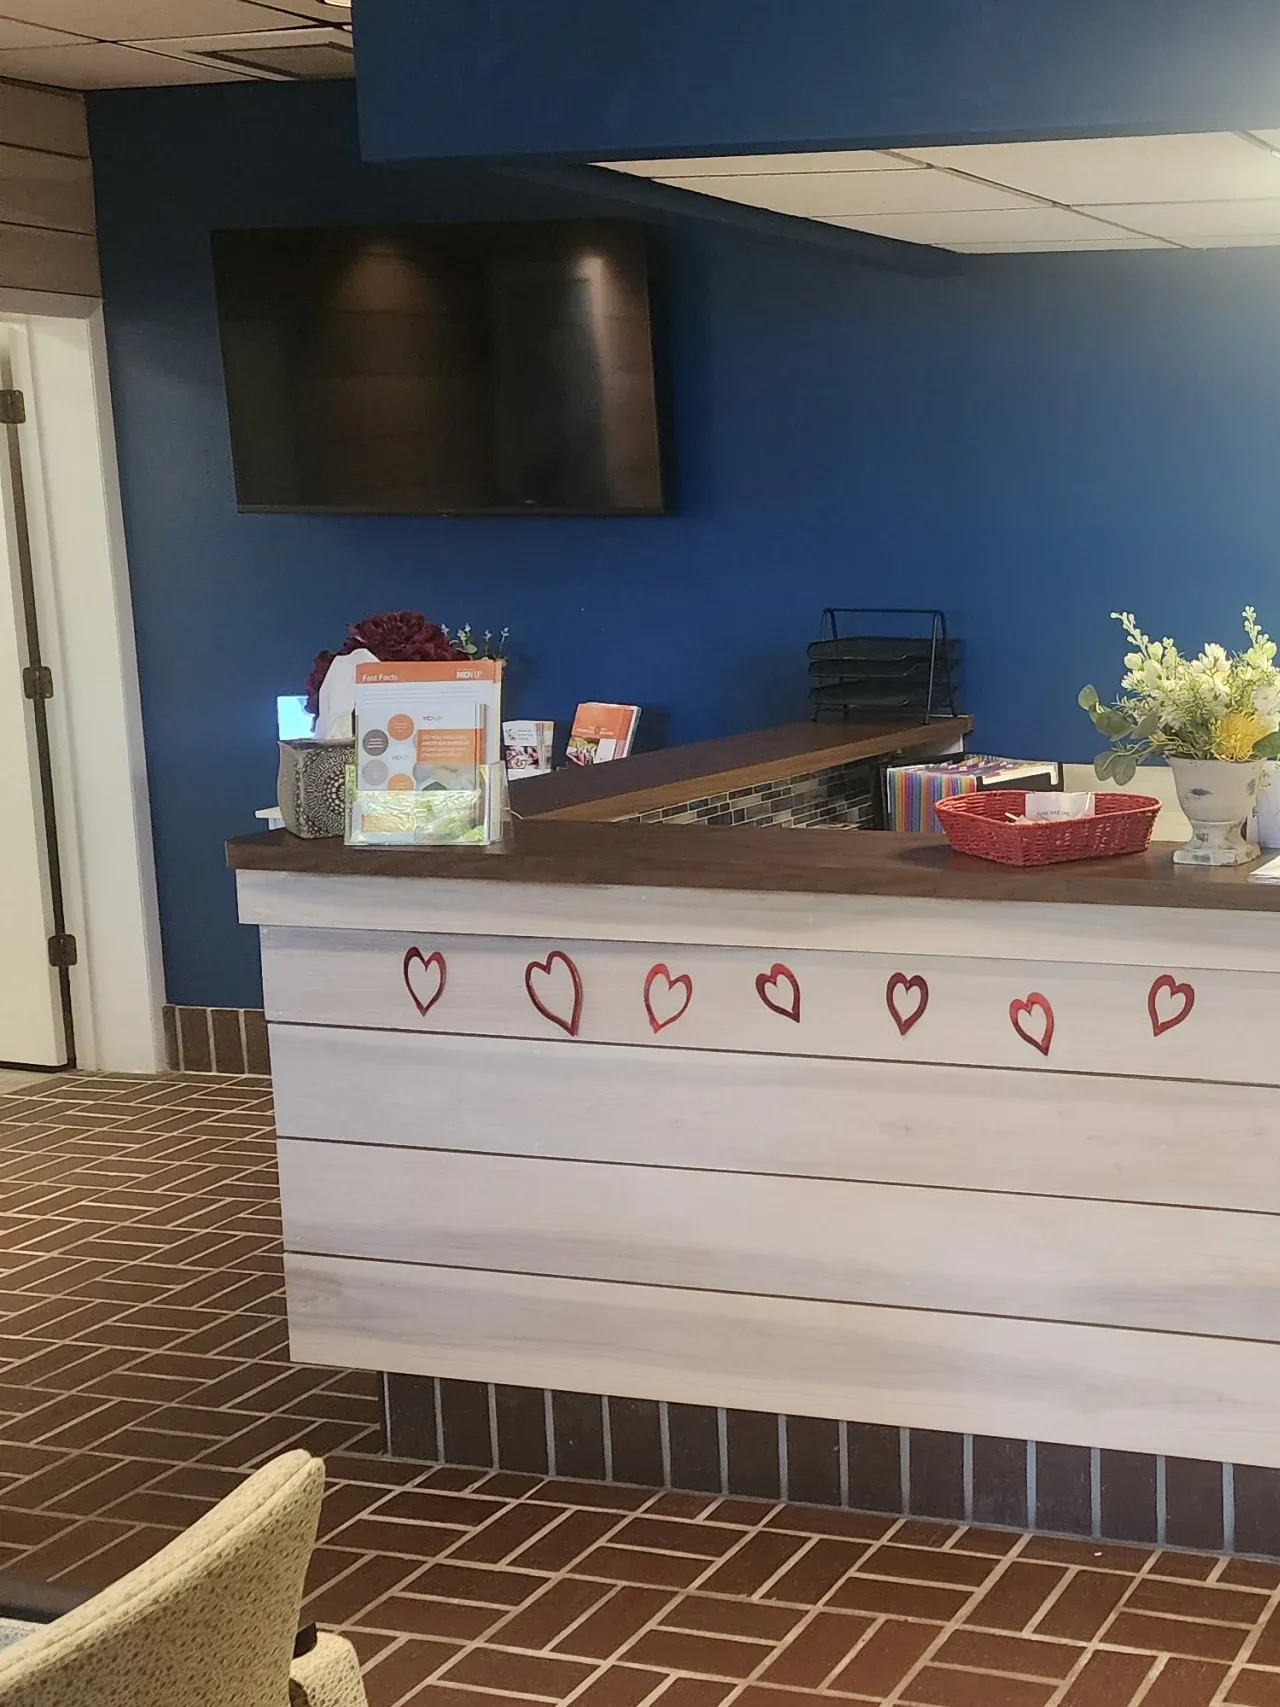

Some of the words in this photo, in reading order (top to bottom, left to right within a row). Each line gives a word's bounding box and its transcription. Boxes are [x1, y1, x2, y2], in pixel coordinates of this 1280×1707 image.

[362, 674, 377, 682] Fast
[379, 673, 398, 681] Facts
[456, 670, 482, 679] MDVIP
